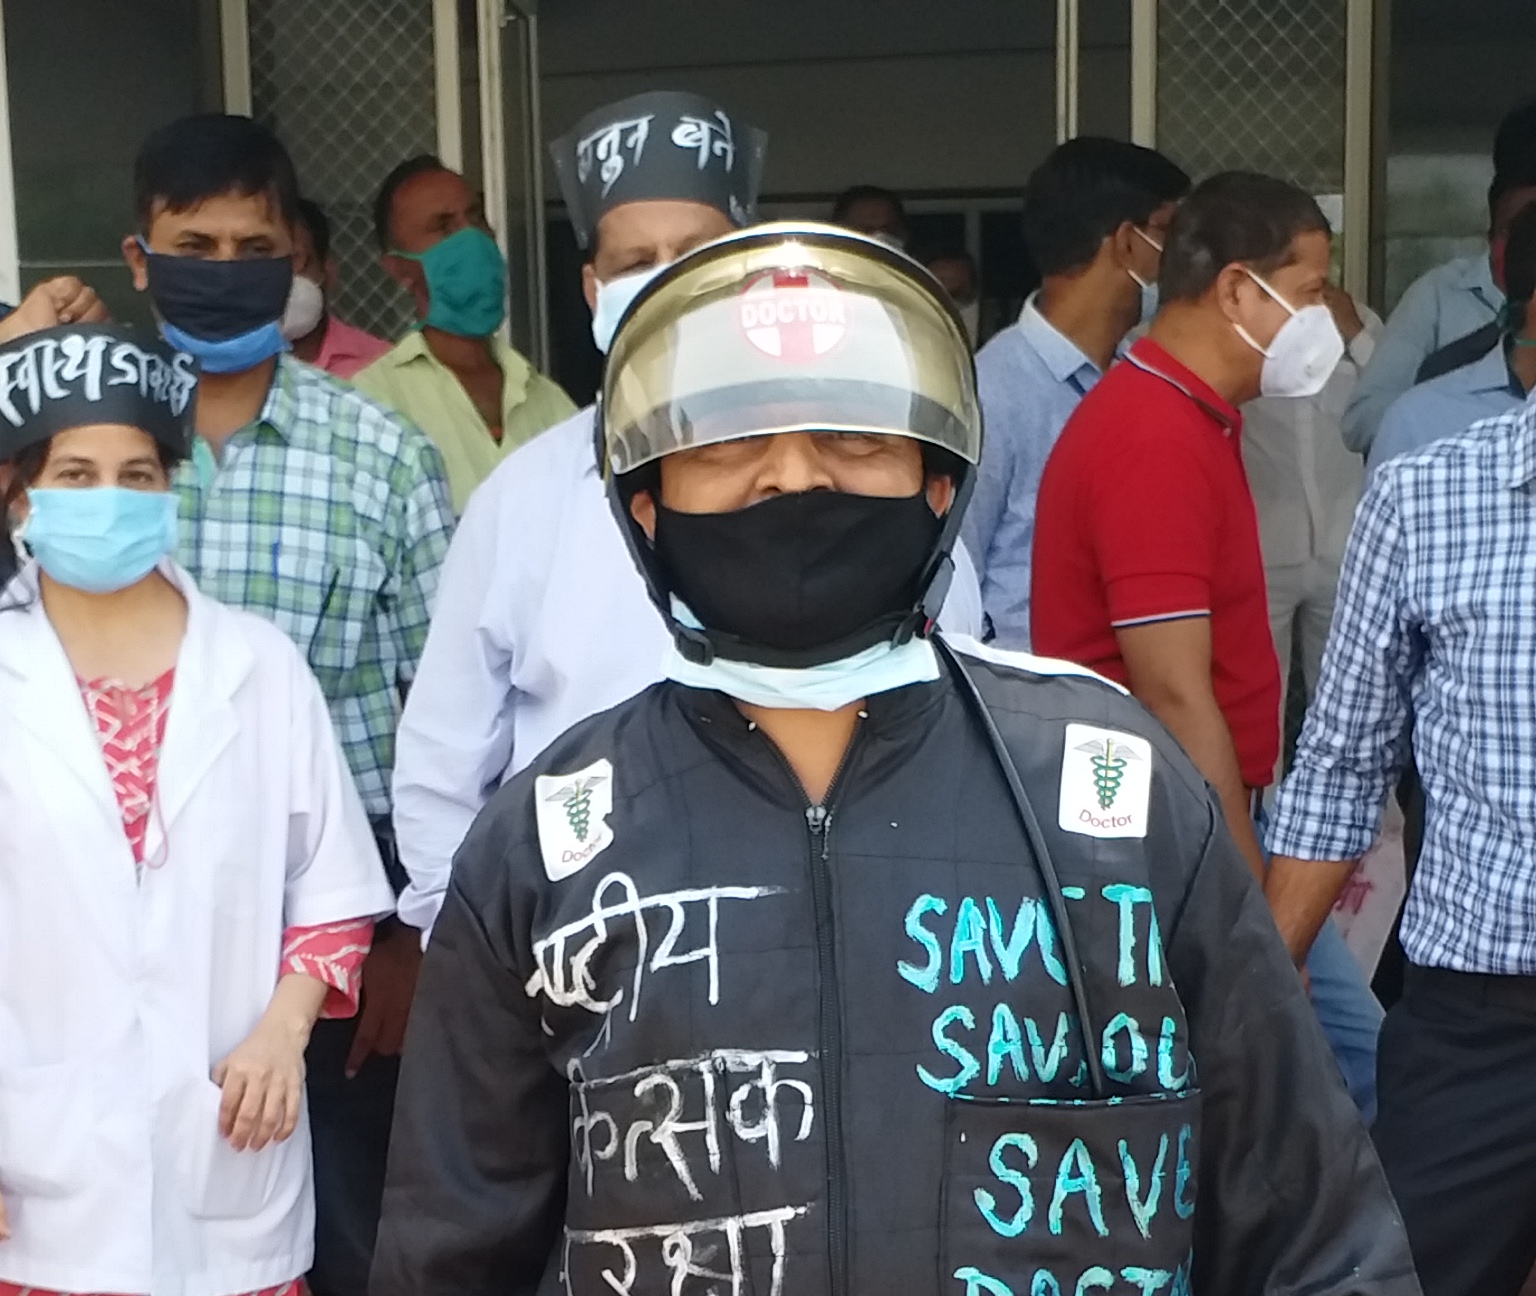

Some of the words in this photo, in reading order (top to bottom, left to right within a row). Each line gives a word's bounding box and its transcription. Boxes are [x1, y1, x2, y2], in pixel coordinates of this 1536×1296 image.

[671, 109, 736, 173] बने
[740, 298, 846, 329] DOCTOR
[1078, 808, 1133, 829] Doctor
